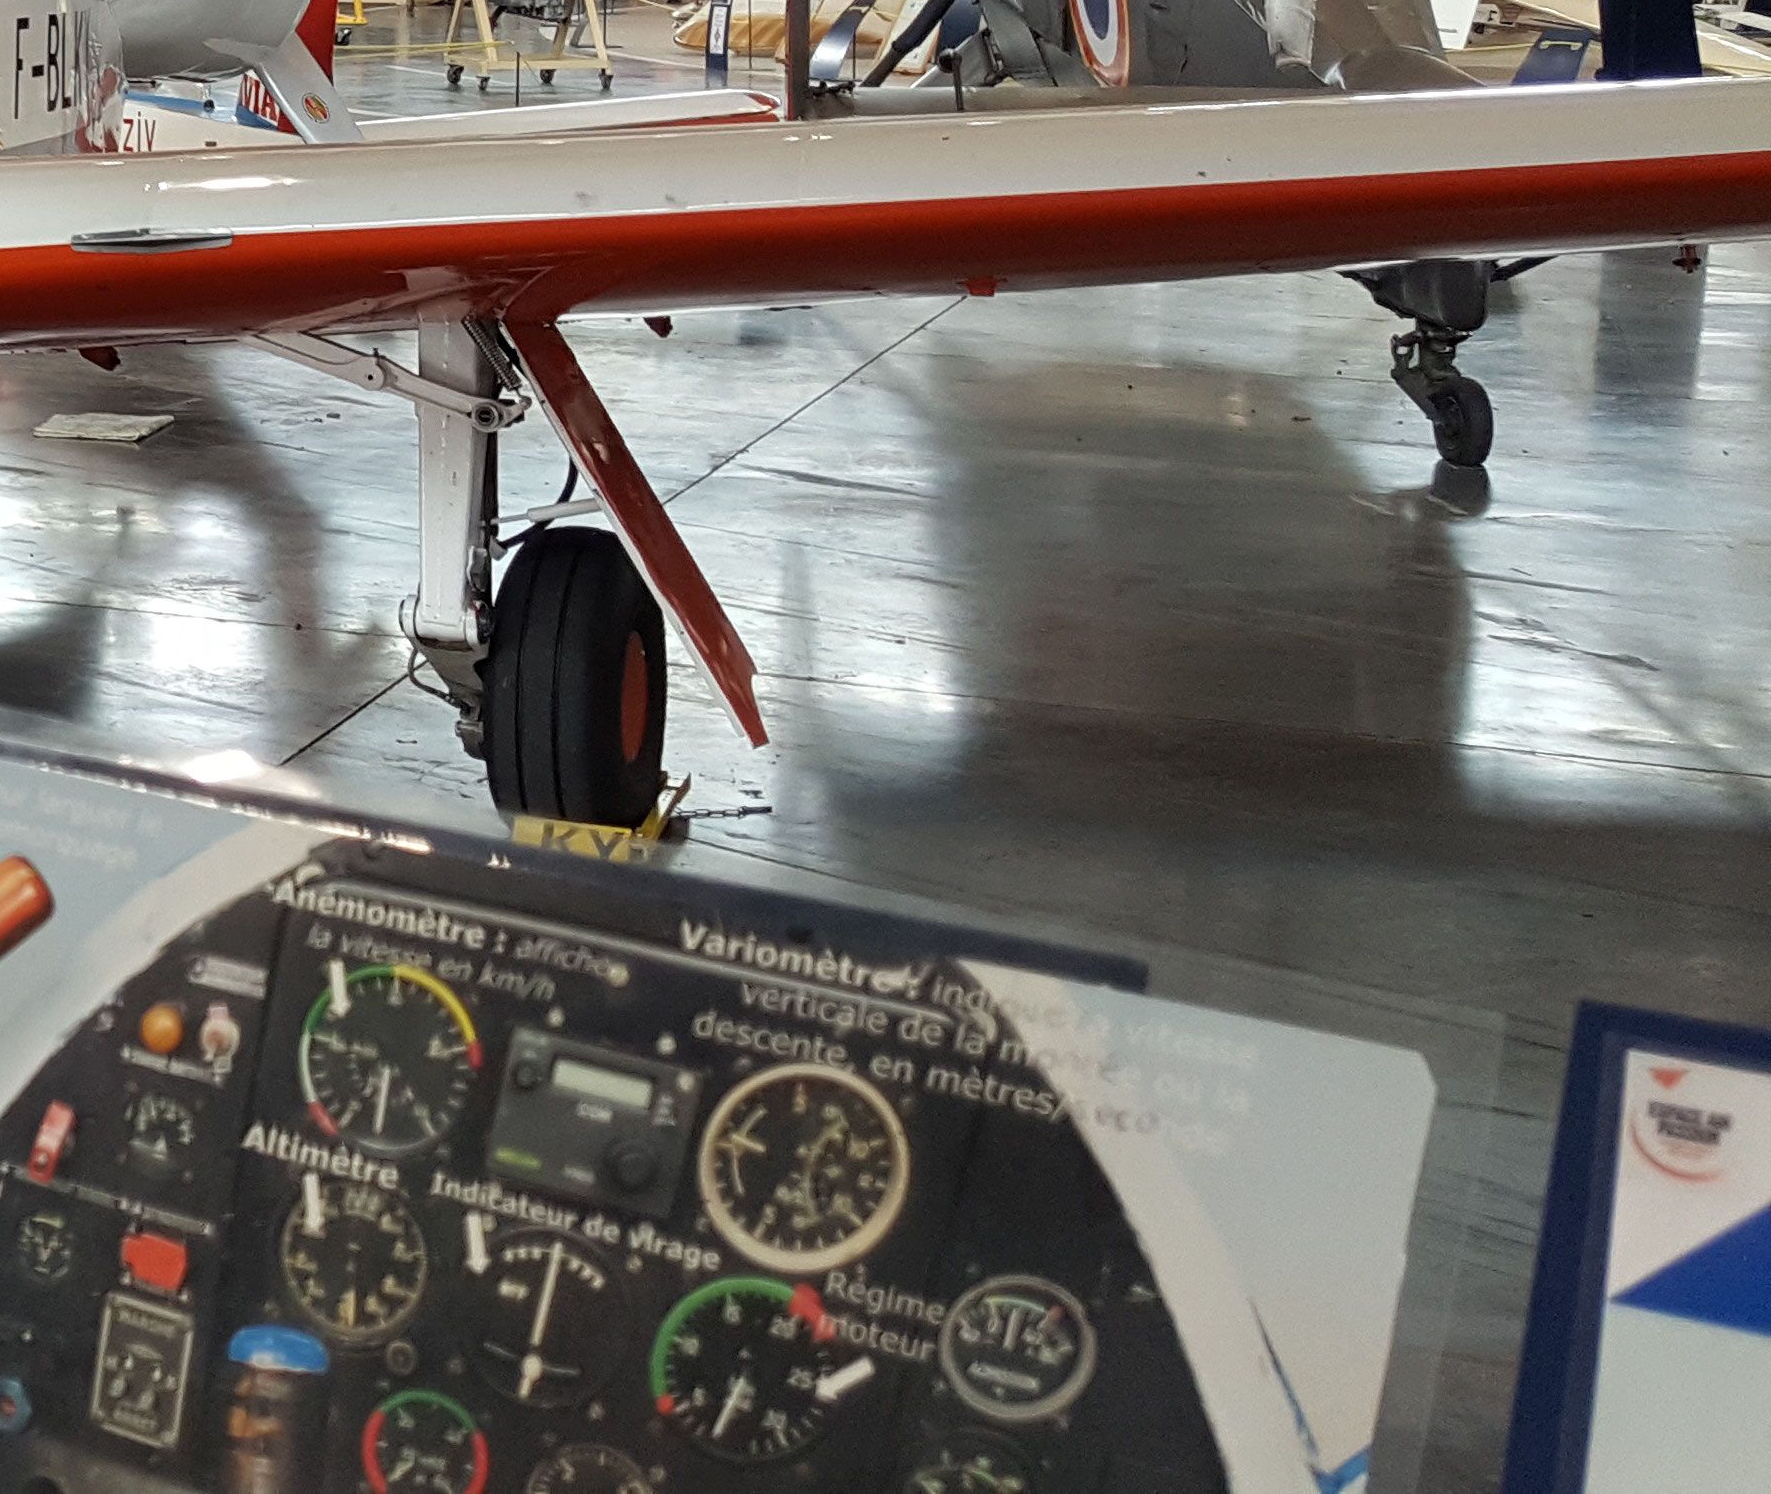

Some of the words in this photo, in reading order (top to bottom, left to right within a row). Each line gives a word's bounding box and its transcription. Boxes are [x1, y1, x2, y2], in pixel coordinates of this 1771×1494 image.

[739, 980, 889, 1036] verticale
[896, 1007, 943, 1047] de
[868, 1050, 915, 1084] en
[239, 1122, 400, 1191] Altimètre
[582, 1210, 622, 1246] de
